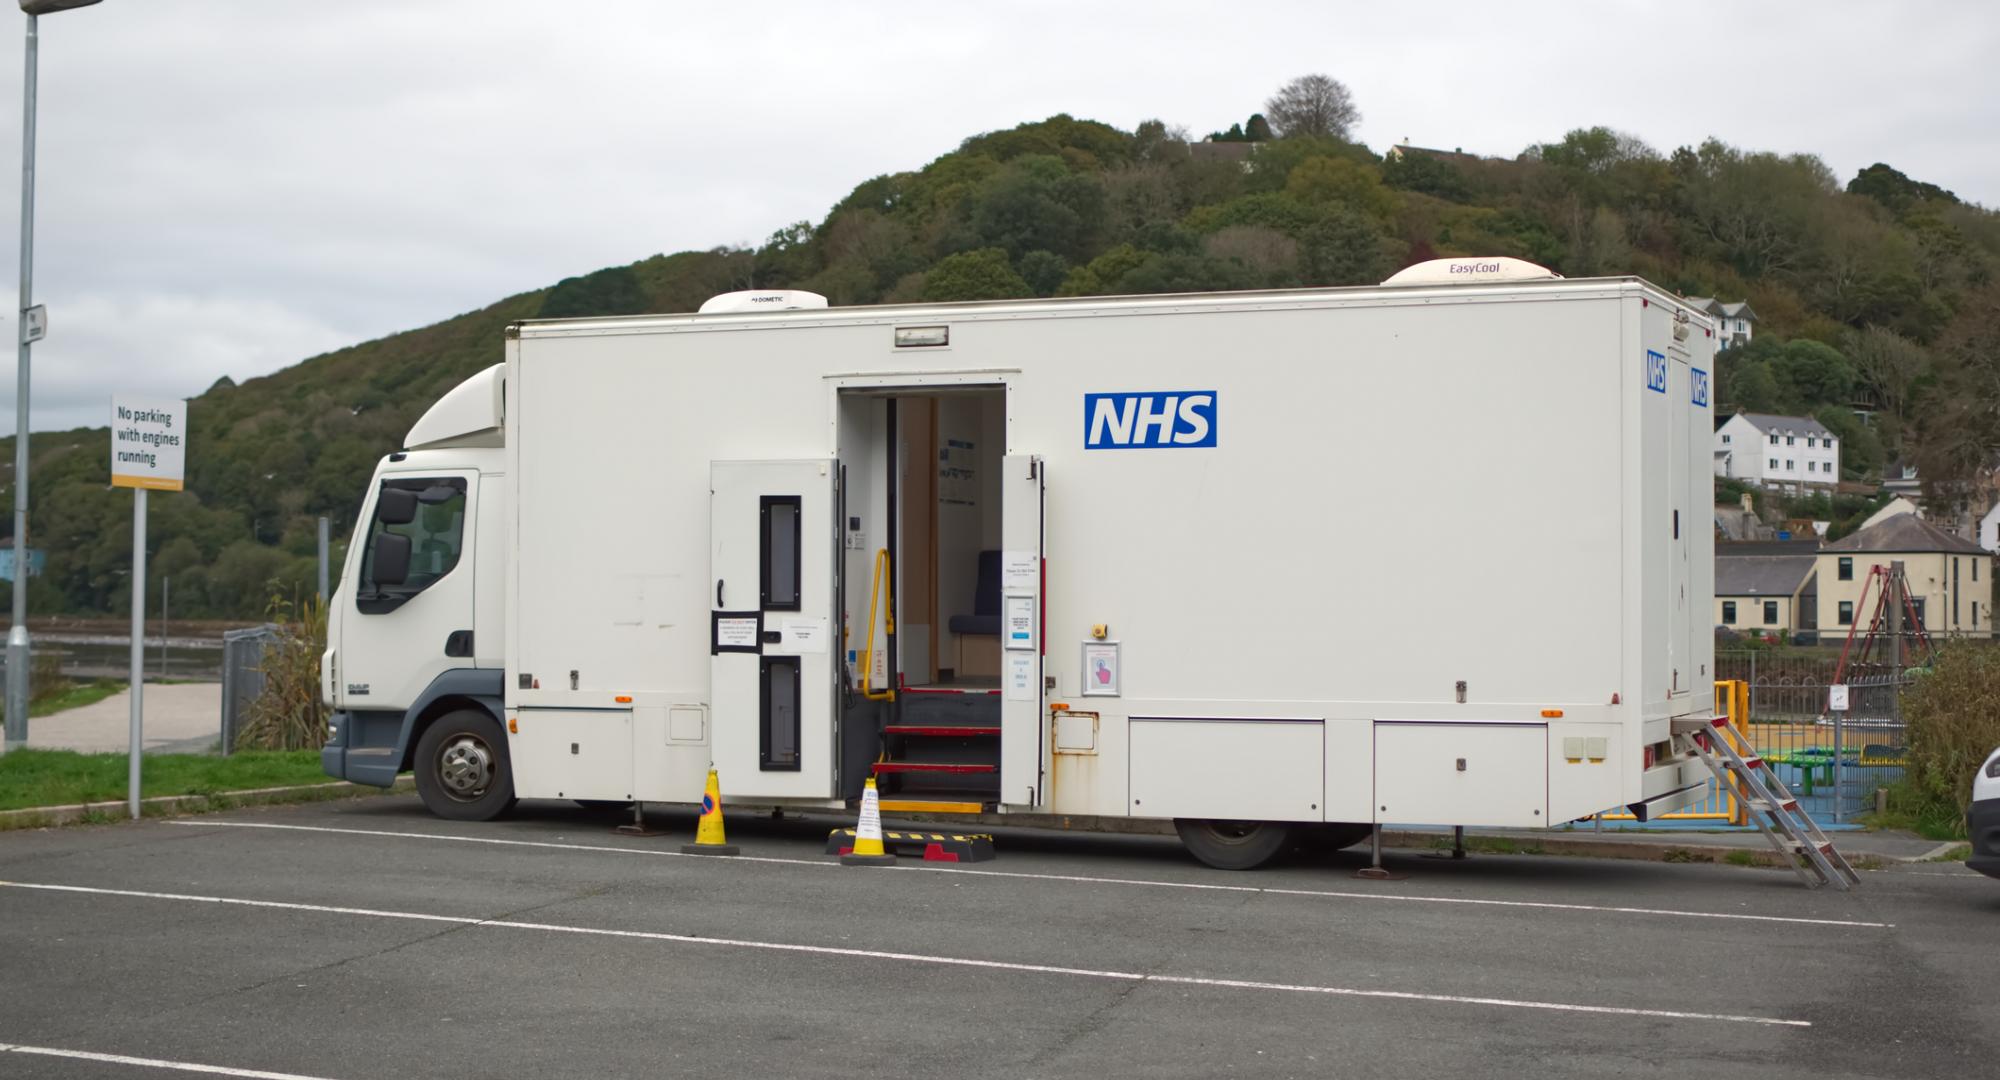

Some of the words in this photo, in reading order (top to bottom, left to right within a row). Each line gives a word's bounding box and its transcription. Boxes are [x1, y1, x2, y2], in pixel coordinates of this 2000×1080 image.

[1449, 262, 1500, 274] EasyCool
[1647, 352, 1665, 392] NHS
[1691, 369, 1707, 405] NHS
[118, 406, 132, 420] No
[134, 409, 172, 428] parking
[1087, 394, 1212, 445] NHS
[118, 427, 140, 442] with
[142, 430, 179, 447] engines
[118, 450, 156, 468] running
